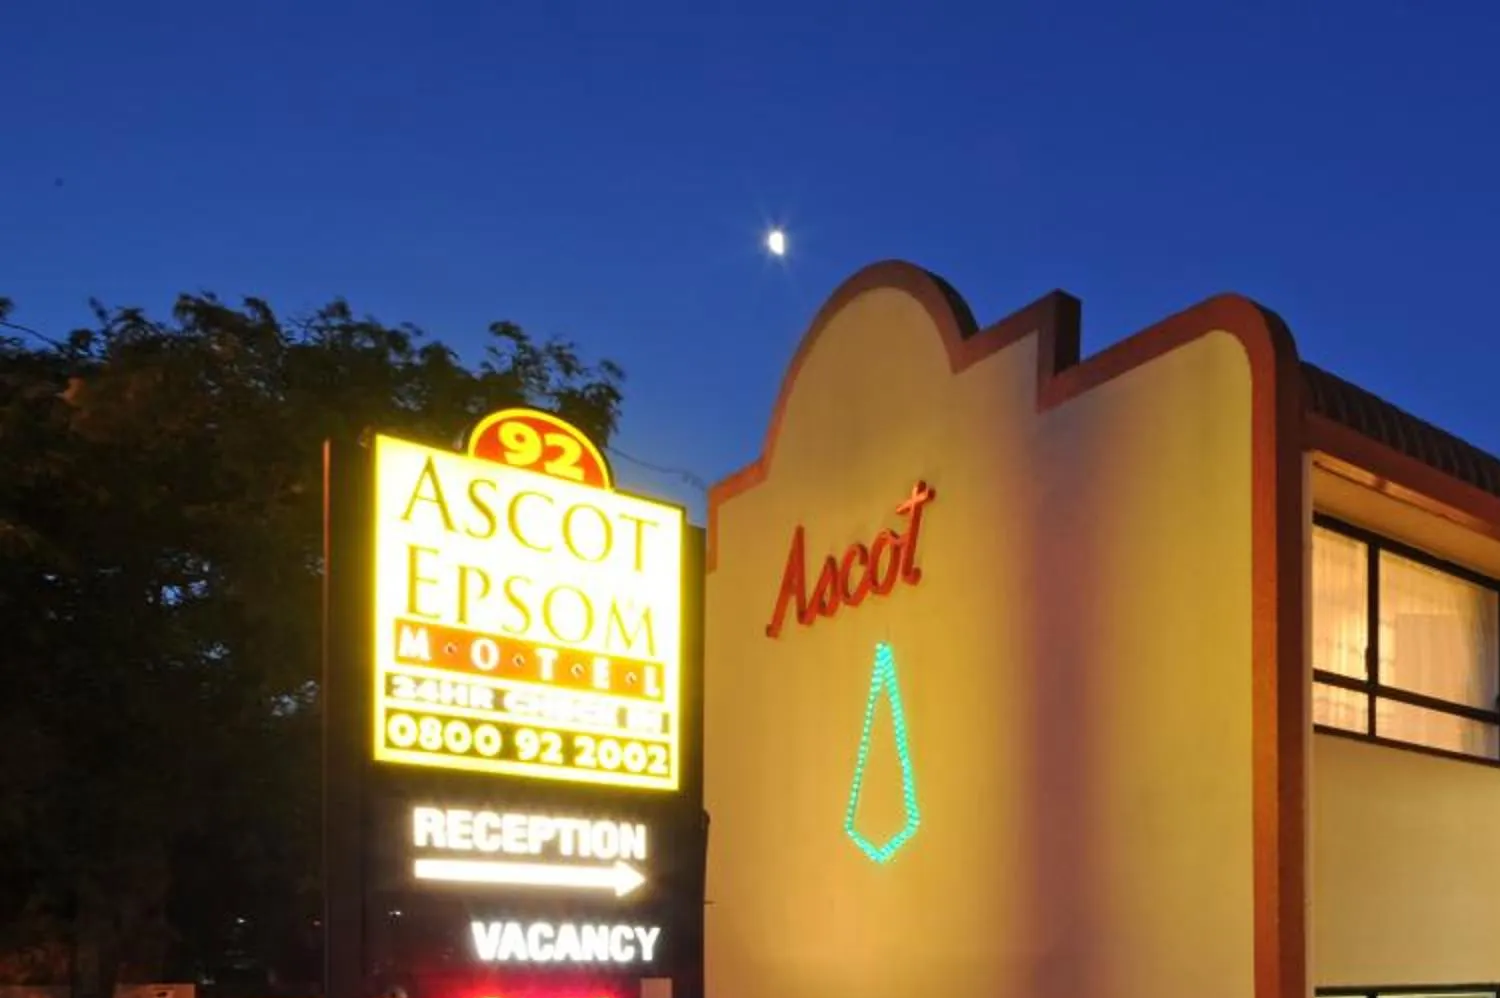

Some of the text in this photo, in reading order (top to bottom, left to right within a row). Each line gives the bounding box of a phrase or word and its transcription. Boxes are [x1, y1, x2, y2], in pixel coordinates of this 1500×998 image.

[498, 420, 585, 482] 92
[399, 455, 661, 573] ASCOT
[765, 480, 936, 639] Ascot
[405, 543, 657, 657] EPSOM
[387, 713, 669, 775] 0800 92 2002
[413, 806, 647, 860] RECEPTION
[470, 920, 660, 962] VACANCY
